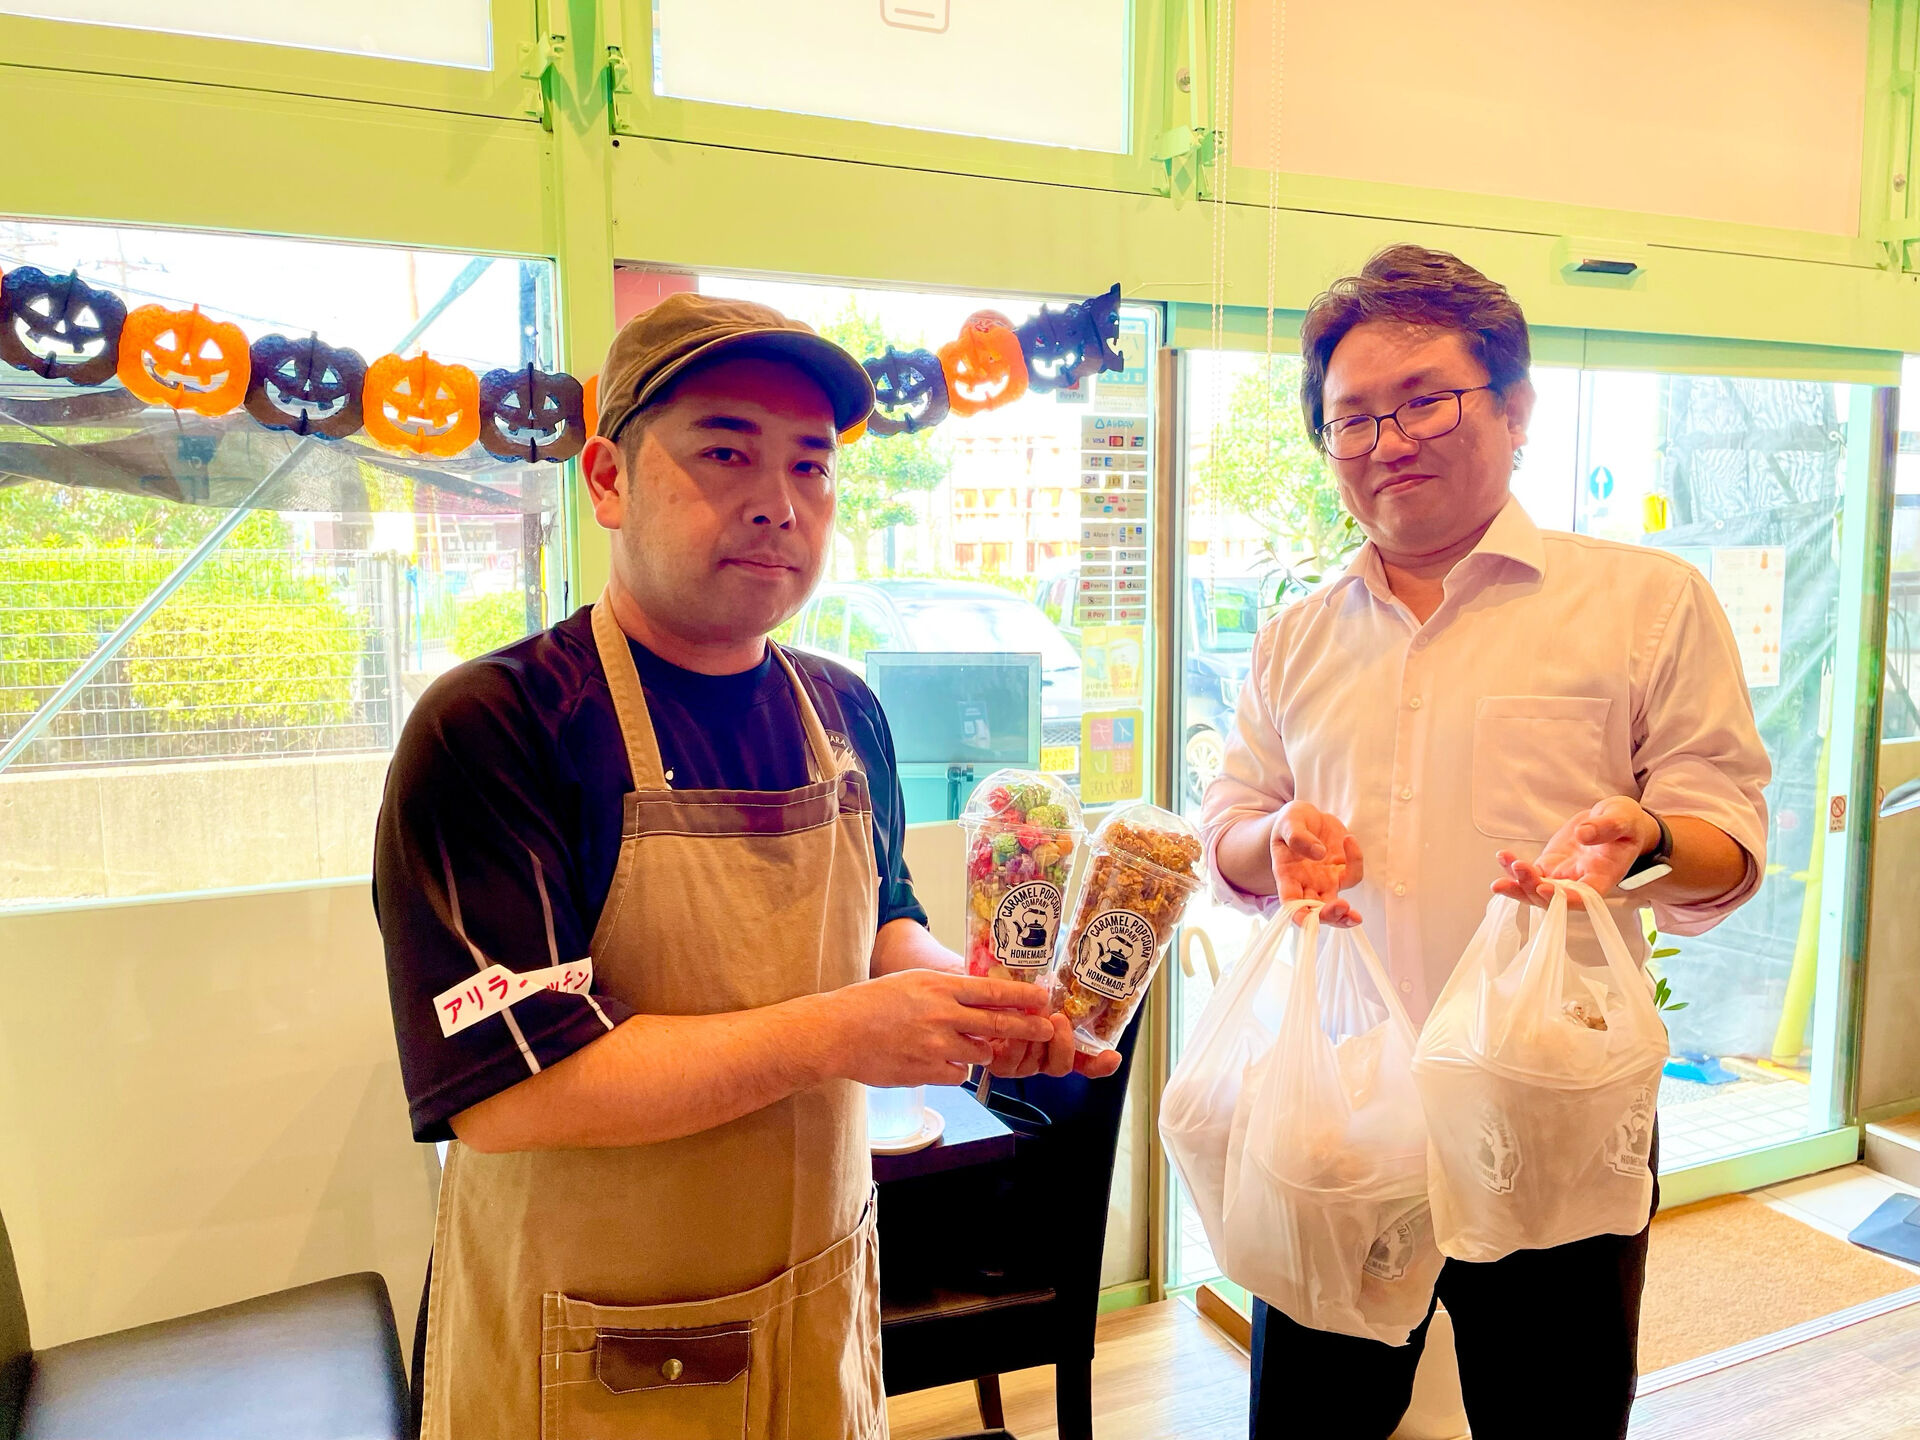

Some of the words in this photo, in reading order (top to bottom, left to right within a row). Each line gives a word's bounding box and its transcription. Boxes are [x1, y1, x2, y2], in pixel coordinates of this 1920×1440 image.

[1001, 887, 1038, 918] CARAMEL
[1039, 887, 1061, 919] POPCORN
[1021, 898, 1050, 910] COMPANY
[1090, 915, 1129, 938] CARAMEL
[1130, 919, 1152, 959] POPCORN
[1110, 926, 1140, 943] COMPANY
[1010, 949, 1048, 959] HOMEMADE
[1086, 968, 1126, 991] HOMEMADE
